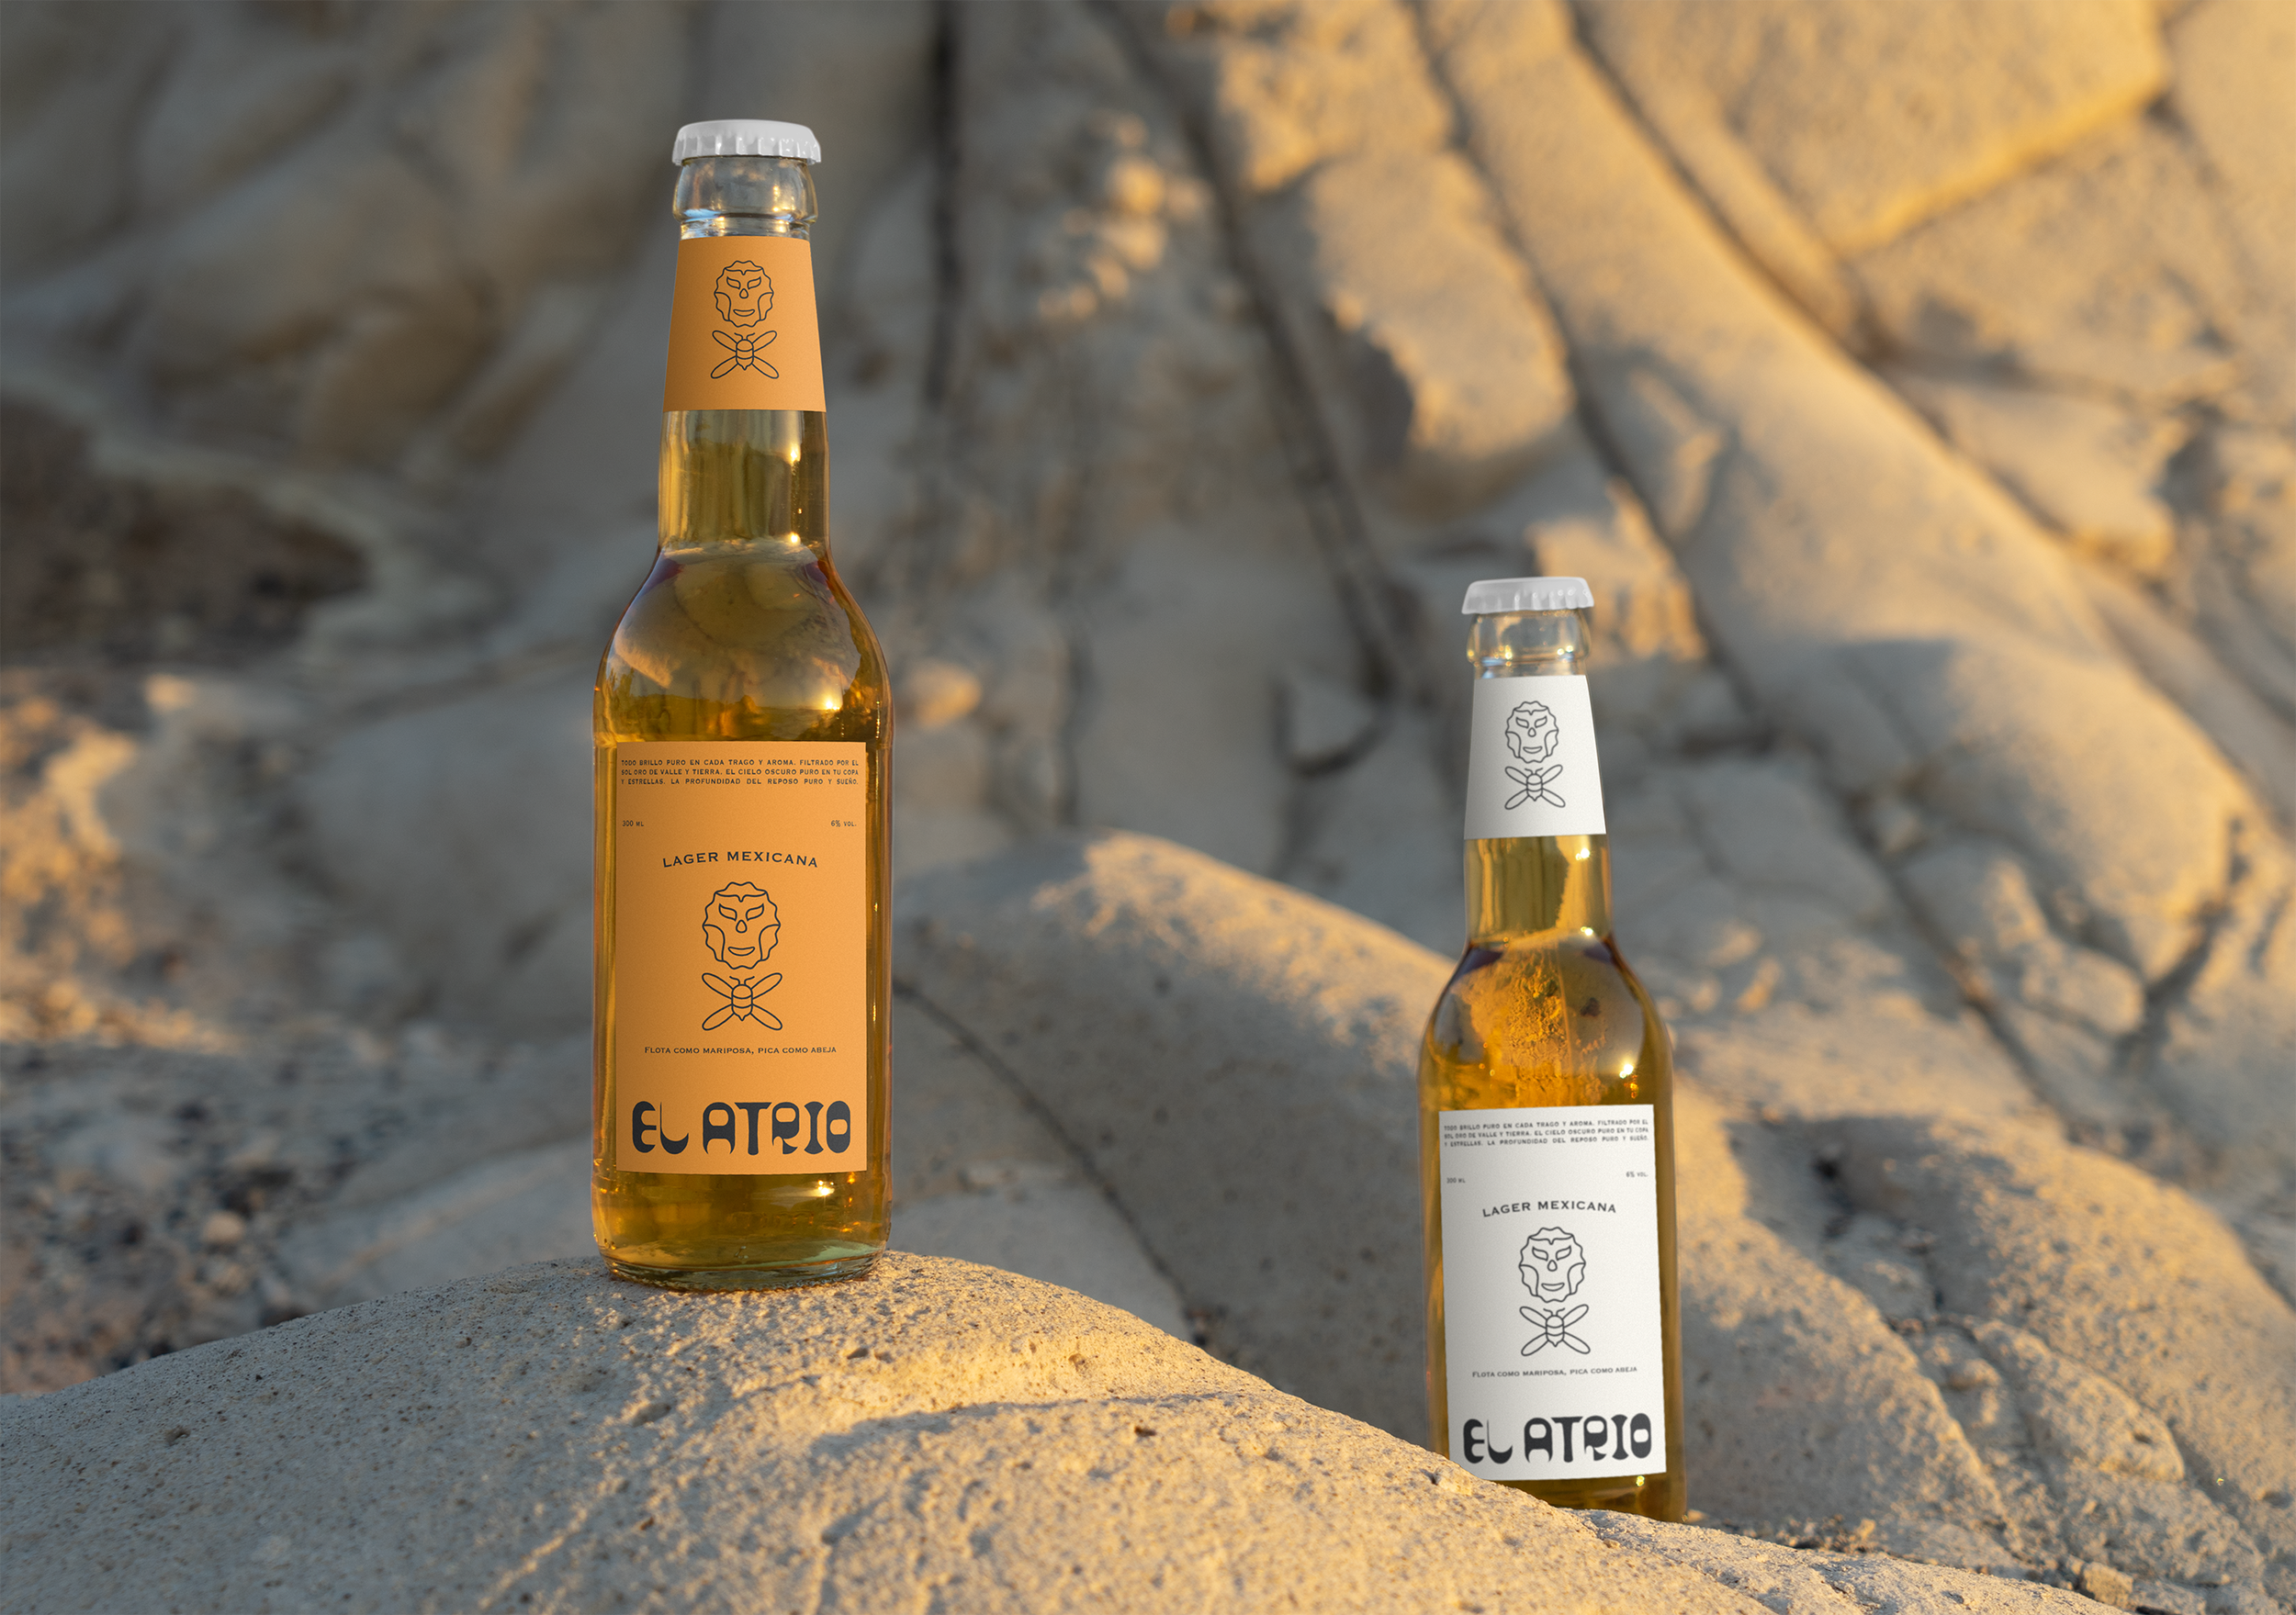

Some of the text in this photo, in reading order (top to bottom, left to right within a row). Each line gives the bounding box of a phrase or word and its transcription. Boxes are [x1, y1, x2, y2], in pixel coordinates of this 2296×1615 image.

[836, 777, 859, 785] SUEÑO.
[662, 851, 818, 868] LAGER MEXICANA
[632, 1100, 851, 1156] EL ATRIO
[1482, 1200, 1616, 1217] LAGER MEXICANA
[1463, 1412, 1652, 1464] EL ATRIO
